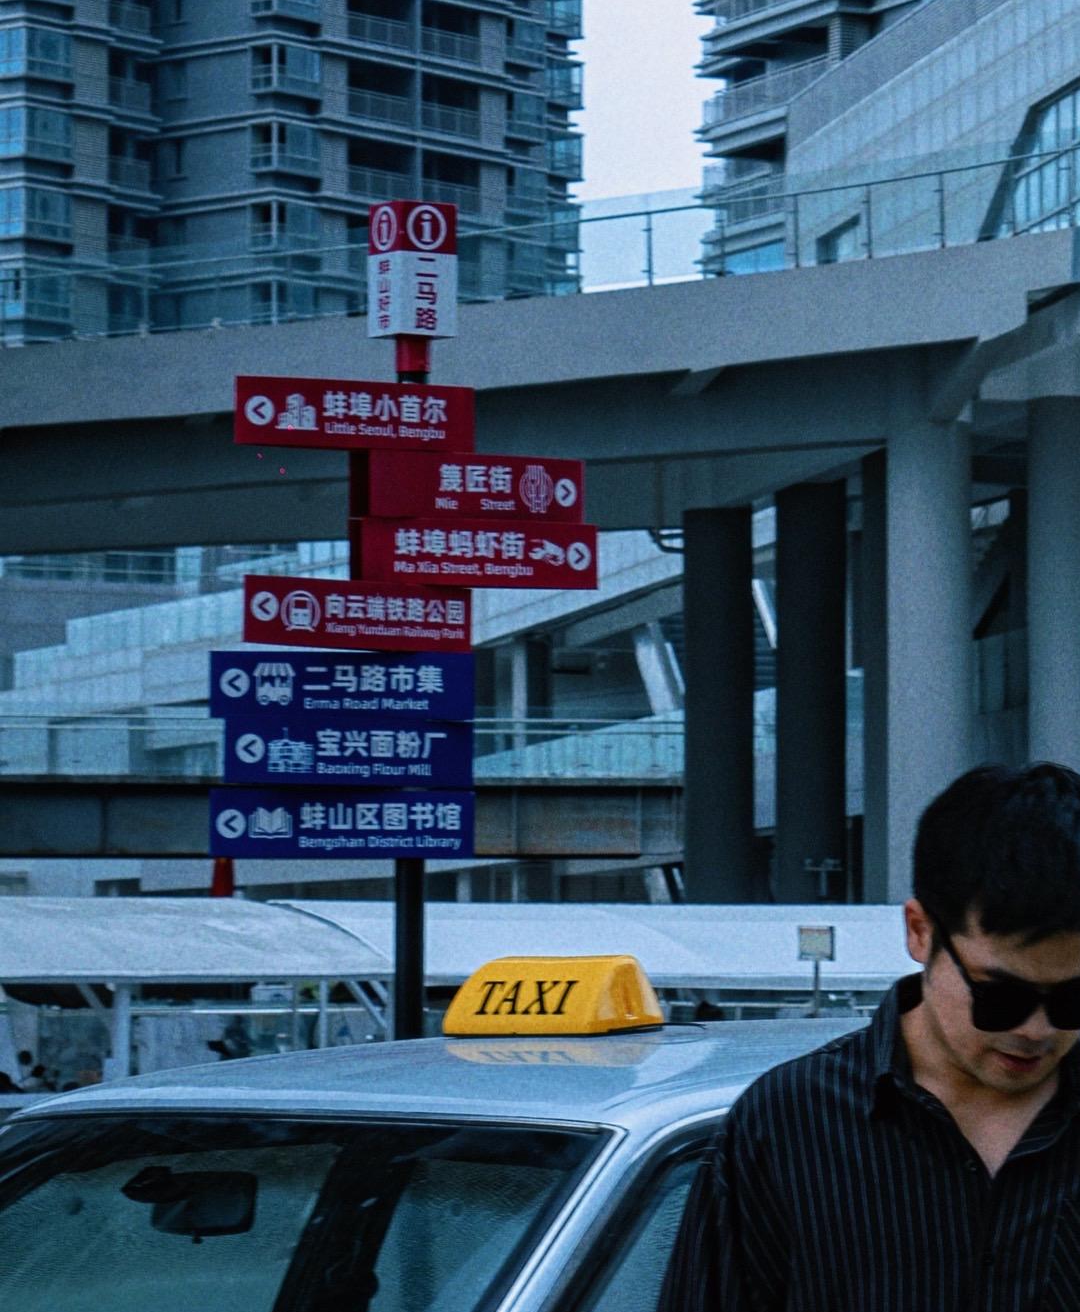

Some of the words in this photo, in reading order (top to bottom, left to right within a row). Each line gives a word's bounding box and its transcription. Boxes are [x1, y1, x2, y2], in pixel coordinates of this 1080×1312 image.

[415, 257, 438, 330] 二马路
[322, 391, 448, 424] 蚌埠小首尔
[324, 422, 357, 435] Little
[358, 423, 397, 439] Seoul,
[398, 426, 446, 442] Bengbu
[480, 498, 516, 511] Street
[394, 528, 526, 560] 蚌埠蚂虾街
[484, 563, 534, 578] Bengbu
[325, 594, 465, 625] 向云端铁路公园
[302, 664, 444, 694] 二马路市集
[303, 697, 340, 710] Erma
[342, 697, 379, 710] Road
[381, 697, 430, 710] Market
[316, 728, 448, 759] 宝兴面粉厂
[316, 762, 370, 778] Baoxing
[372, 763, 407, 776] Flour
[407, 764, 432, 776] Mill
[299, 802, 462, 831] 蚌山区图书馆
[298, 836, 366, 851] Bengshan
[367, 836, 415, 848] District
[415, 835, 462, 851] Library
[474, 979, 580, 1016] TAXI
